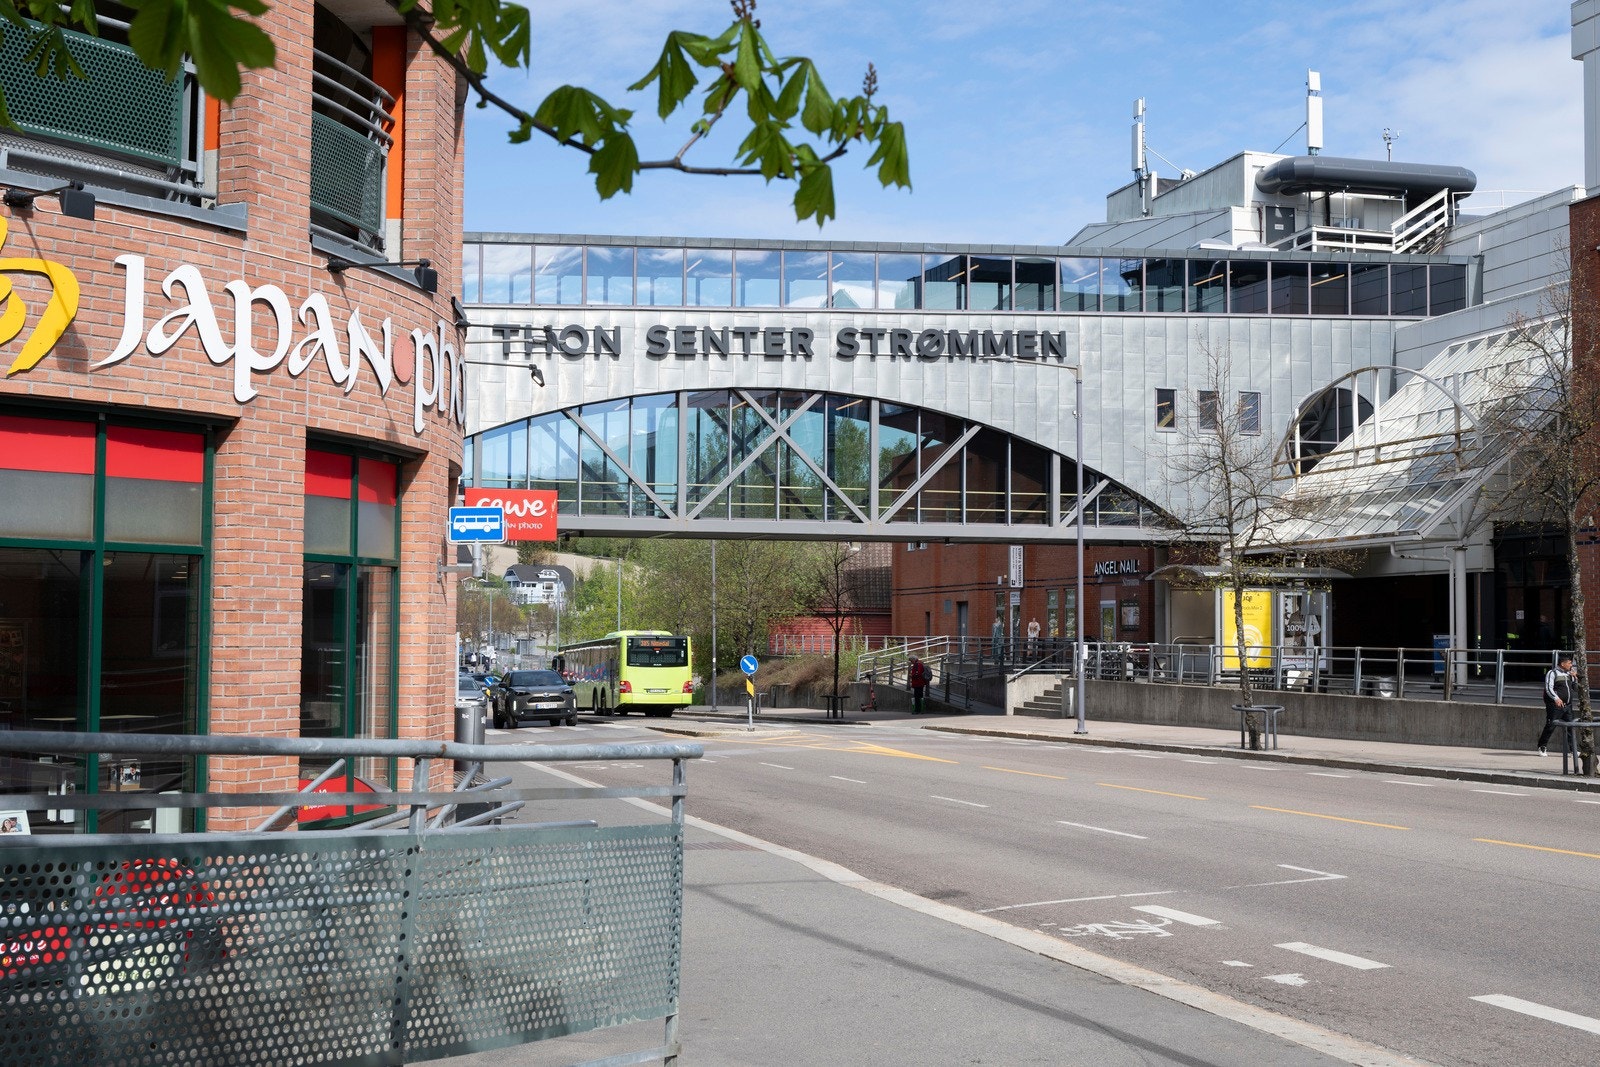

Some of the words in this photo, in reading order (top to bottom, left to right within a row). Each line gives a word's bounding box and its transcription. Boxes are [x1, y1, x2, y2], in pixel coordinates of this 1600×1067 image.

[493, 323, 622, 355] THON
[646, 324, 815, 356] SENTER
[836, 327, 1067, 358] STRØMMEN
[1094, 560, 1119, 576] ANGEL
